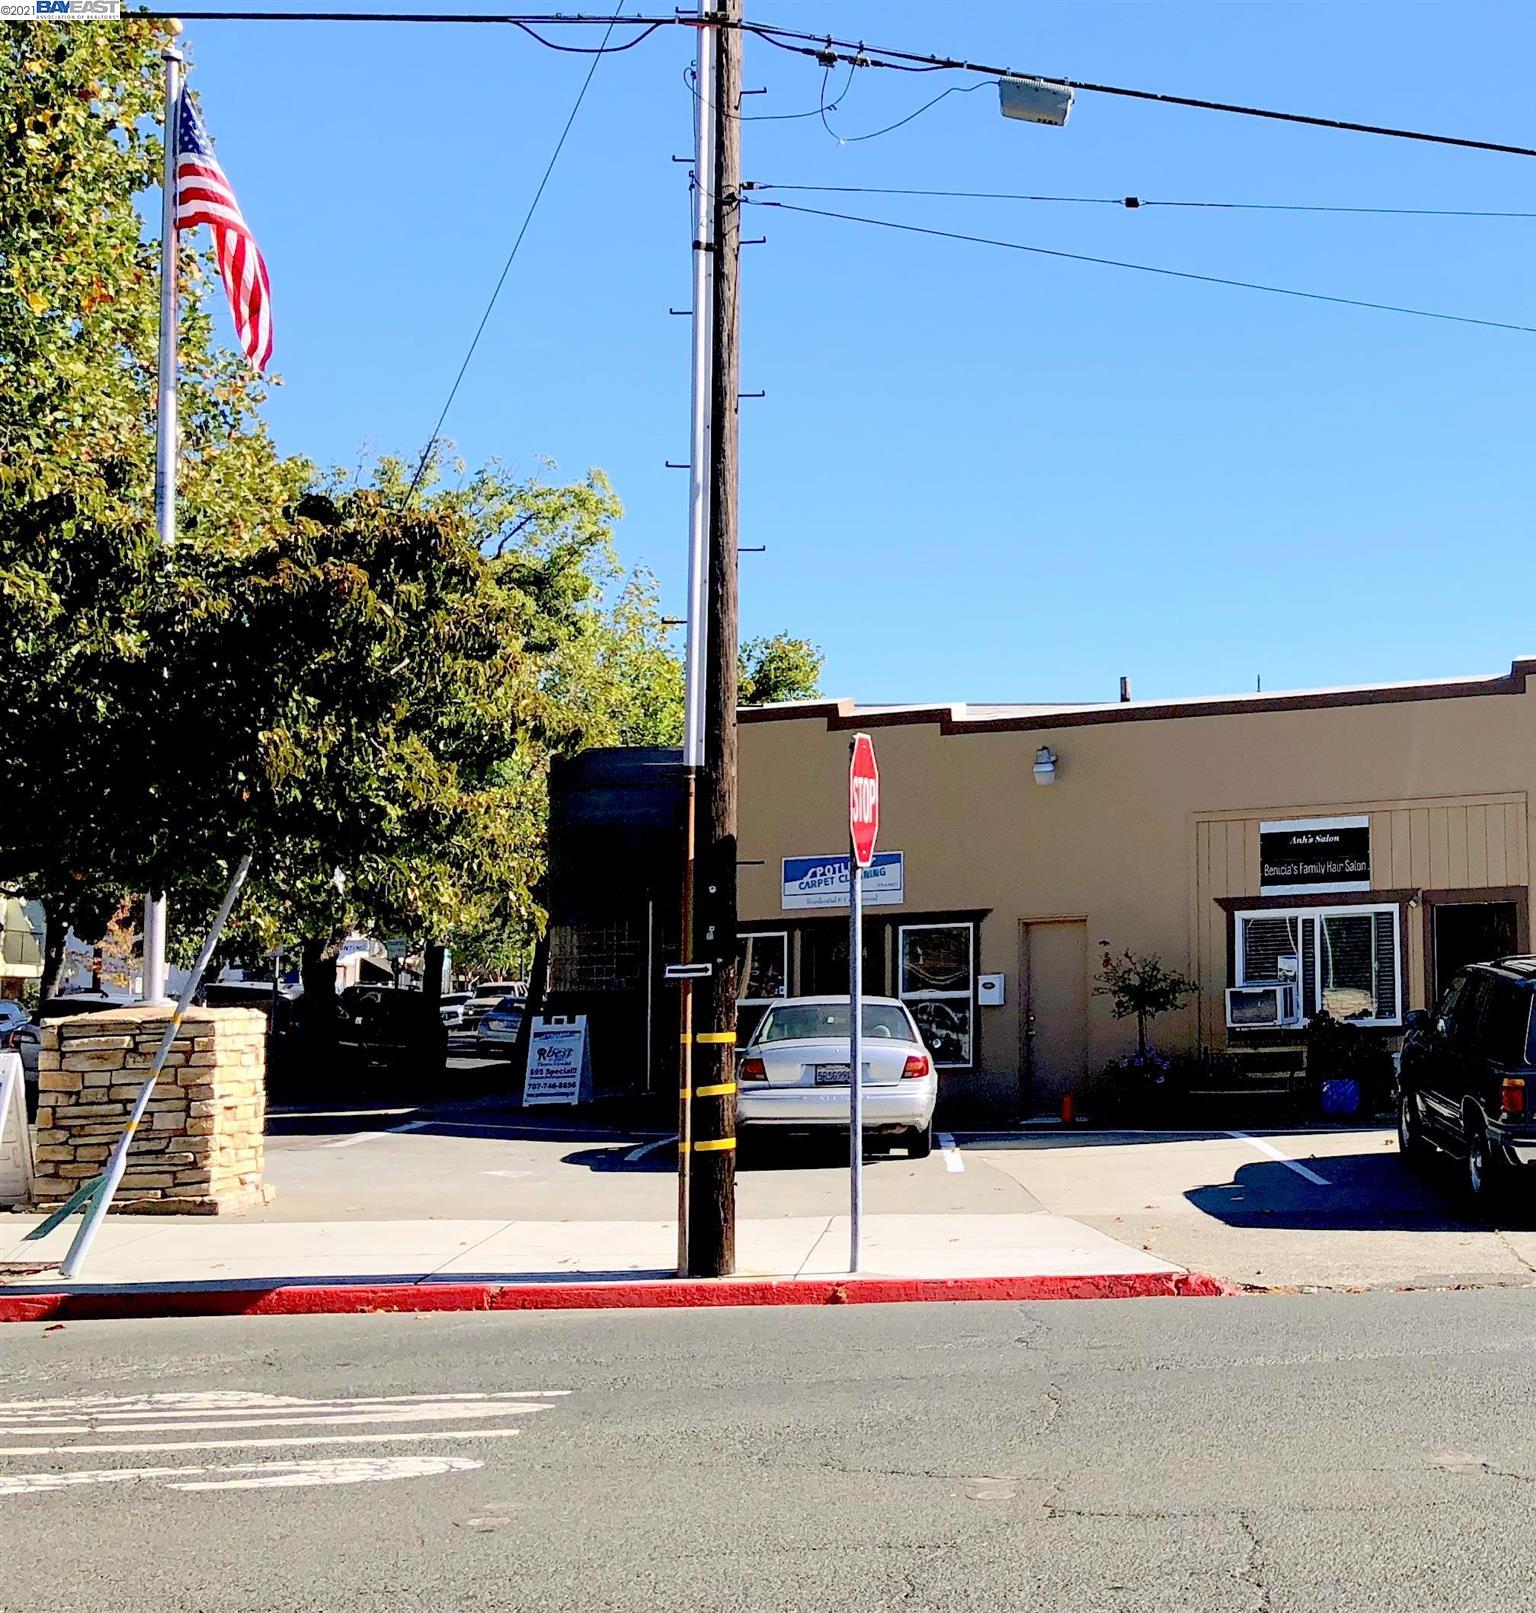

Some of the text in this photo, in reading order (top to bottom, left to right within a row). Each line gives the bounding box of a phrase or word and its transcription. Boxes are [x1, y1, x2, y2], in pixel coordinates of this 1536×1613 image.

[853, 775, 876, 824] STOP
[1289, 834, 1340, 845] Anh's Salon
[798, 866, 887, 890] CARPET CLNING
[1264, 859, 1367, 877] Benicia's Family Hair Salon
